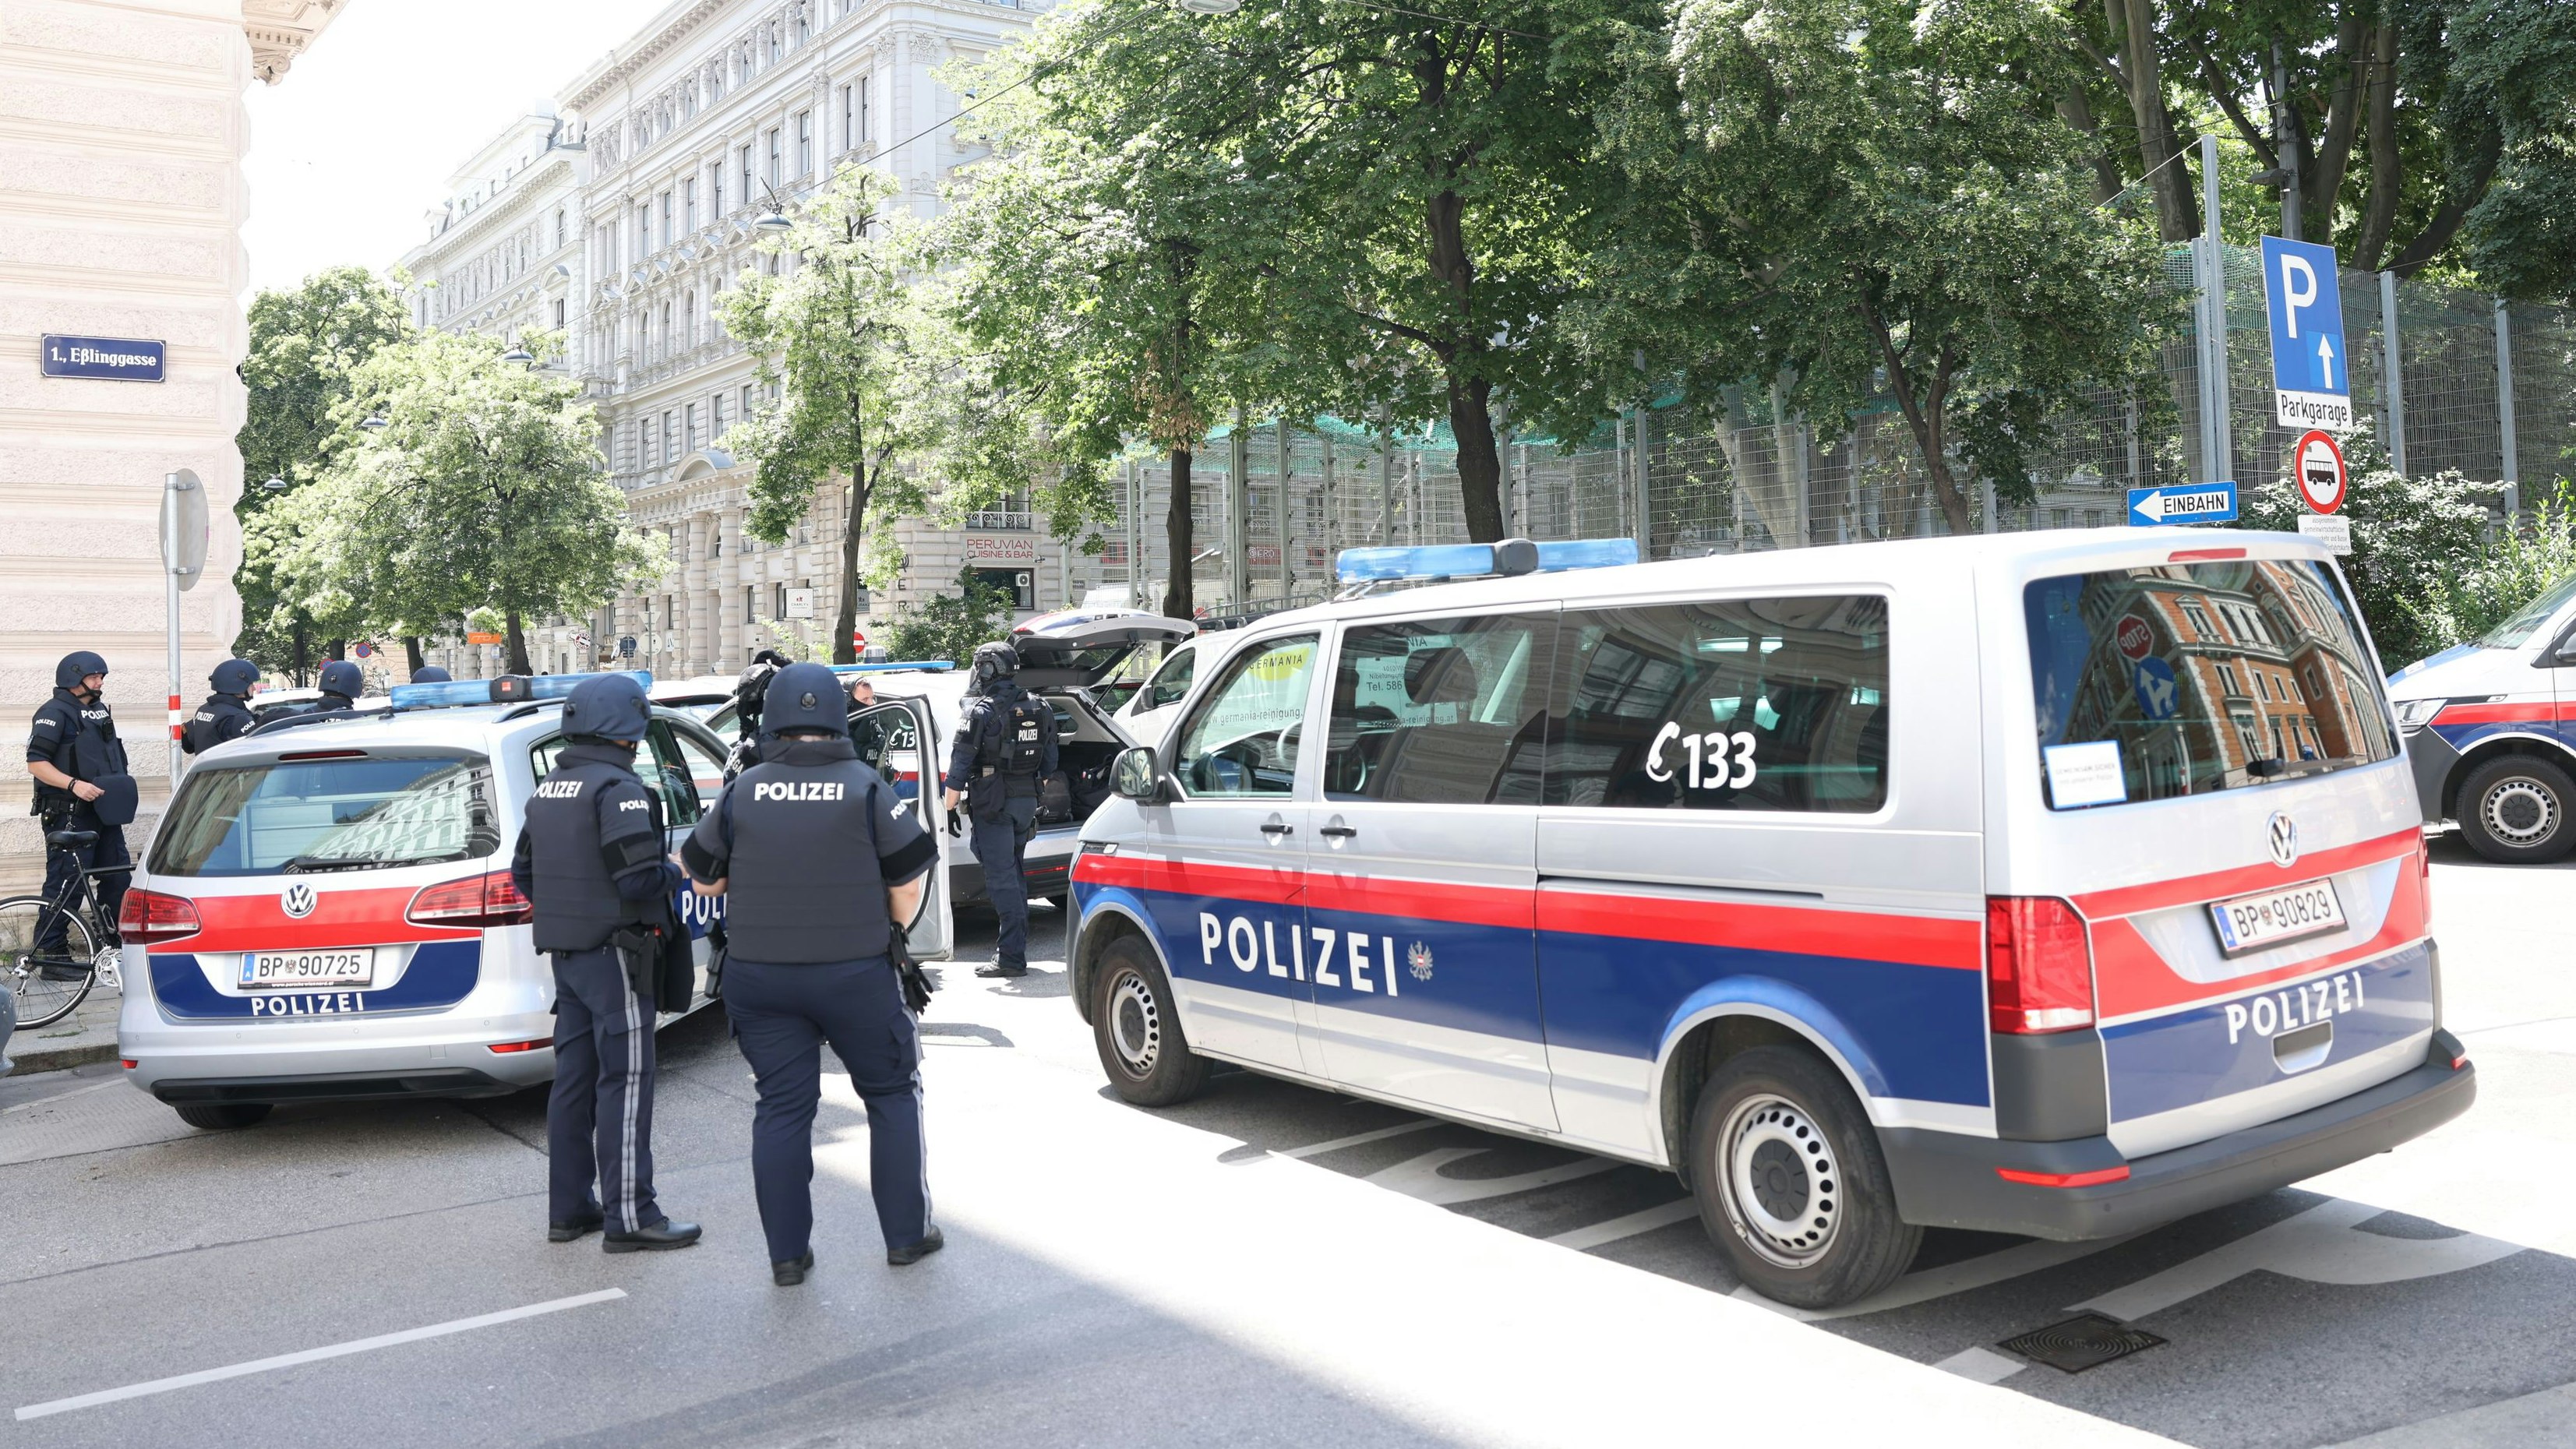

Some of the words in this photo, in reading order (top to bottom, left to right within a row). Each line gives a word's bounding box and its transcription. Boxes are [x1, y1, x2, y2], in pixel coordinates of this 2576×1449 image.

[2281, 254, 2317, 339] P
[2281, 394, 2348, 425] Parkgarage
[2164, 493, 2225, 513] EINBAHN
[967, 539, 1033, 549] PERUVIAN
[967, 550, 1004, 559] CUISINE
[1367, 682, 1383, 692] Tel.
[1387, 681, 1403, 690] 586
[35, 718, 56, 727] POLIZEI
[196, 711, 215, 723] POLIZEI
[902, 731, 916, 748] 13
[1018, 728, 1038, 742] POLIZEI
[1682, 732, 1757, 789] 133
[754, 782, 845, 801] POLIZEI
[682, 890, 728, 928] POLI
[2233, 905, 2258, 938] BP
[2272, 890, 2331, 928] 90829
[1200, 912, 1399, 997] POLIZEI
[259, 957, 283, 977] BP
[298, 954, 362, 976] 90725
[251, 992, 364, 1017] POLIZEI
[2225, 971, 2364, 1045] POLIZEI
